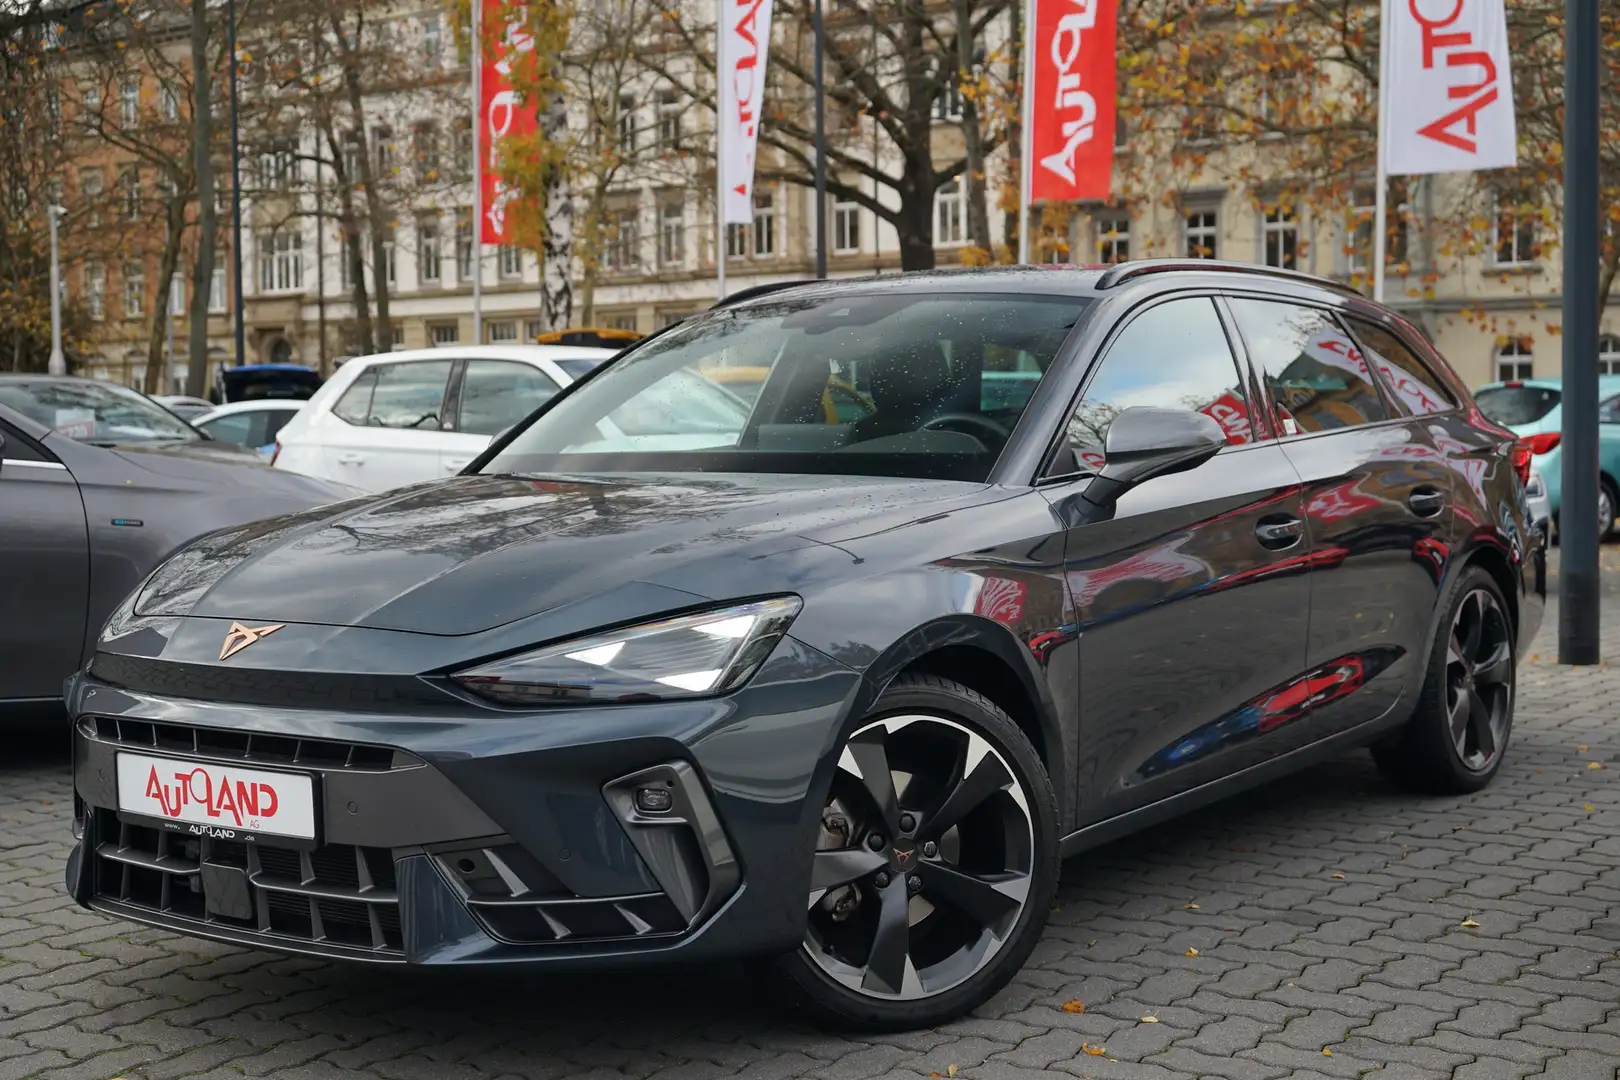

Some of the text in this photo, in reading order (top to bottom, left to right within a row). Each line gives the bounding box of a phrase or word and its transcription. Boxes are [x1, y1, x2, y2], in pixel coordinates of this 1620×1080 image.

[1040, 0, 1098, 187] AUTOL
[145, 764, 279, 826] AUTOLAND
[189, 824, 236, 839] AUTOLAND
[249, 819, 260, 829] AG
